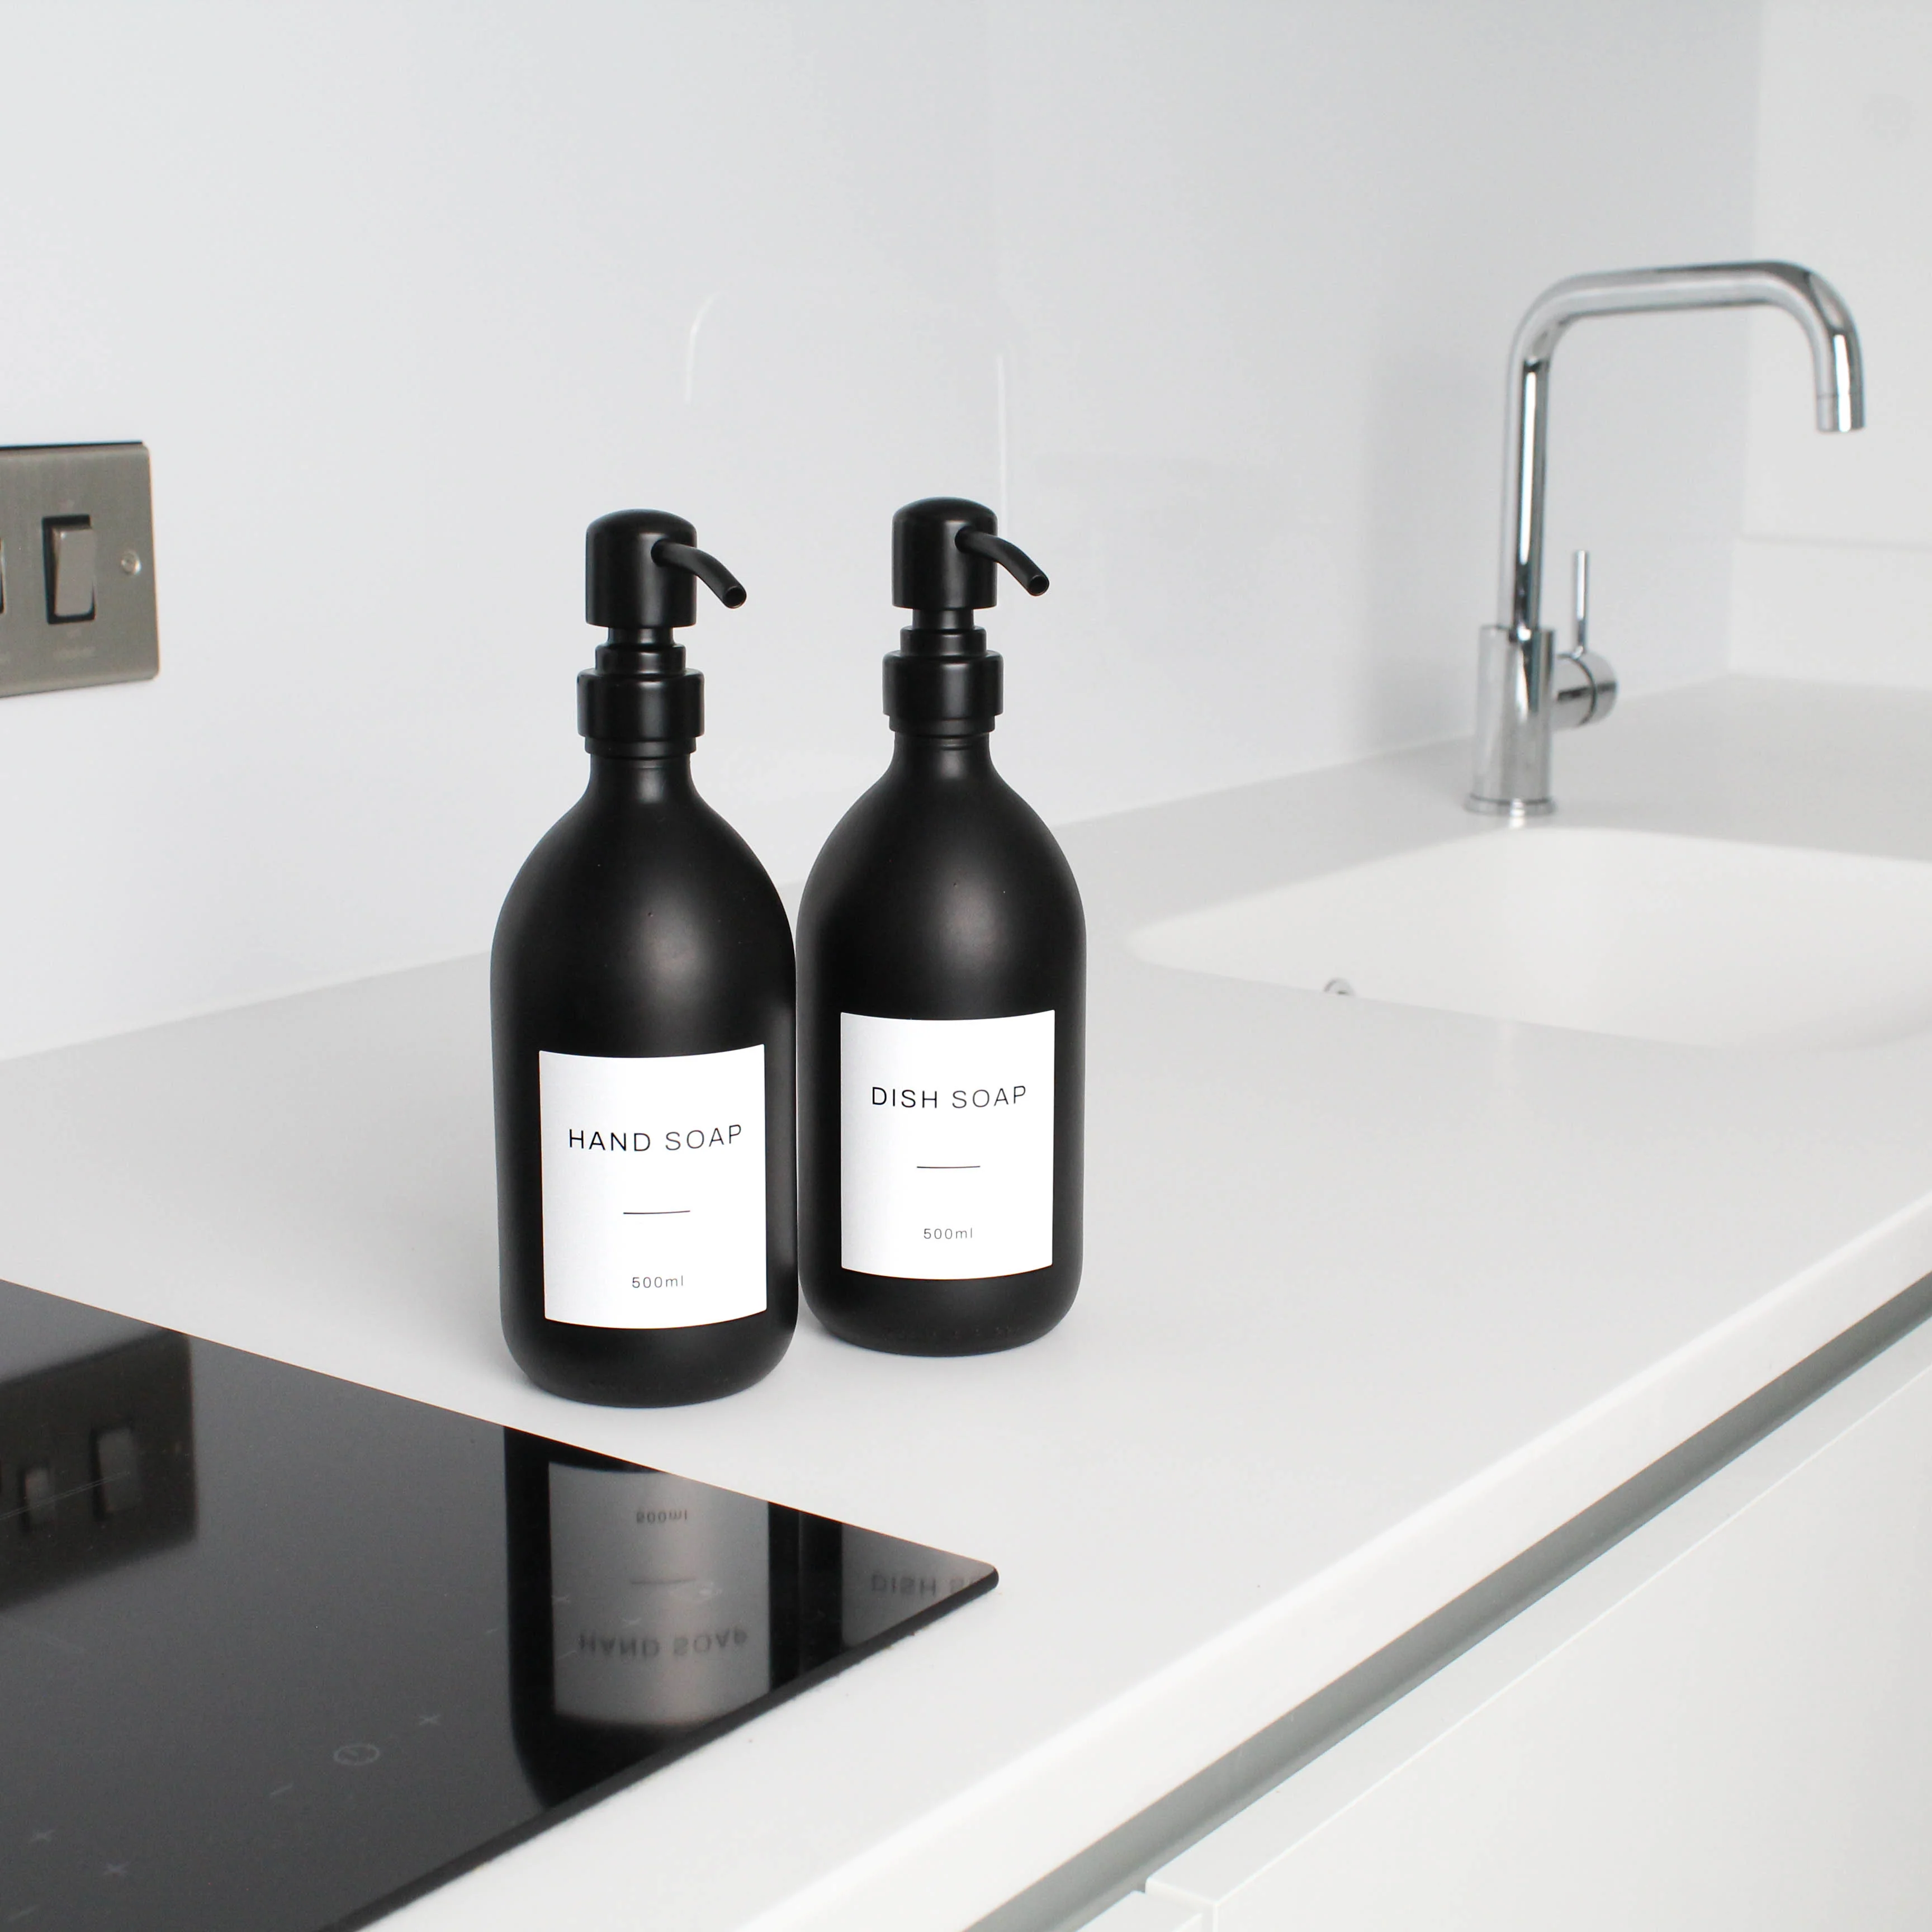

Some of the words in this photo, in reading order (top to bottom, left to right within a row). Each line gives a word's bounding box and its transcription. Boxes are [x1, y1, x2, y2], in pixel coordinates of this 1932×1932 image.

[872, 1086, 937, 1109] DISH
[951, 1085, 1026, 1109] SOAP
[569, 1128, 651, 1152] HAND
[665, 1124, 742, 1151] SOAP
[924, 1227, 973, 1239] 500ml
[632, 1275, 683, 1289] 500ml
